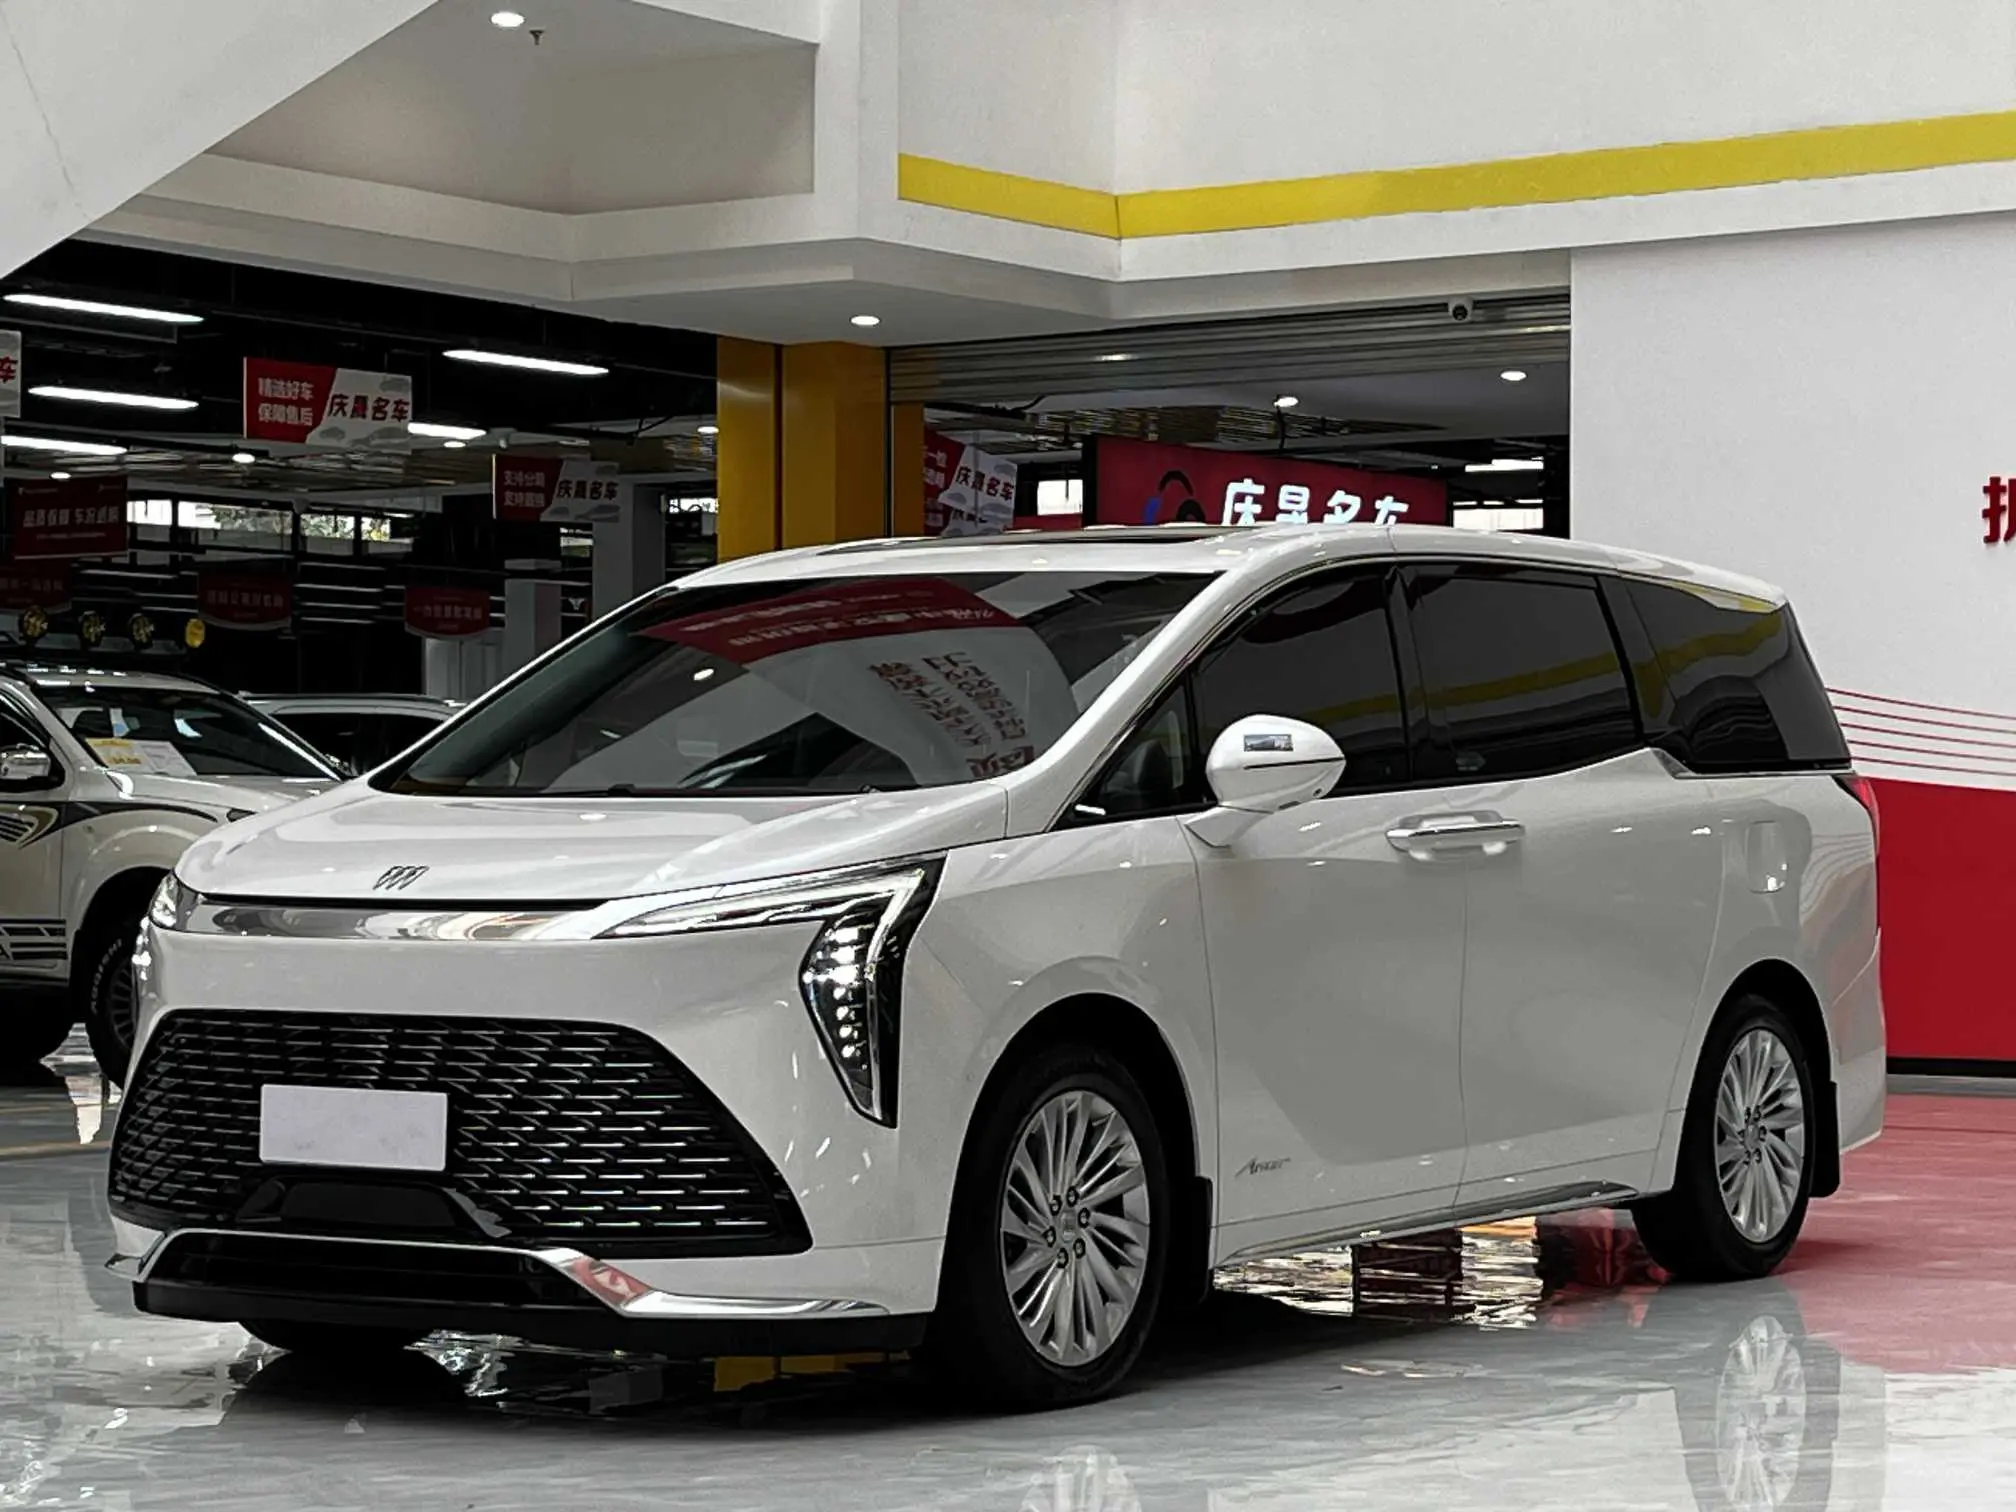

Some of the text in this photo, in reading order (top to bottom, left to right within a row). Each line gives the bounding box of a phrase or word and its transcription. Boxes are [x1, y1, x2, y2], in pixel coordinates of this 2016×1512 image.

[257, 377, 315, 401] 精选好车
[257, 402, 314, 426] 保障售后
